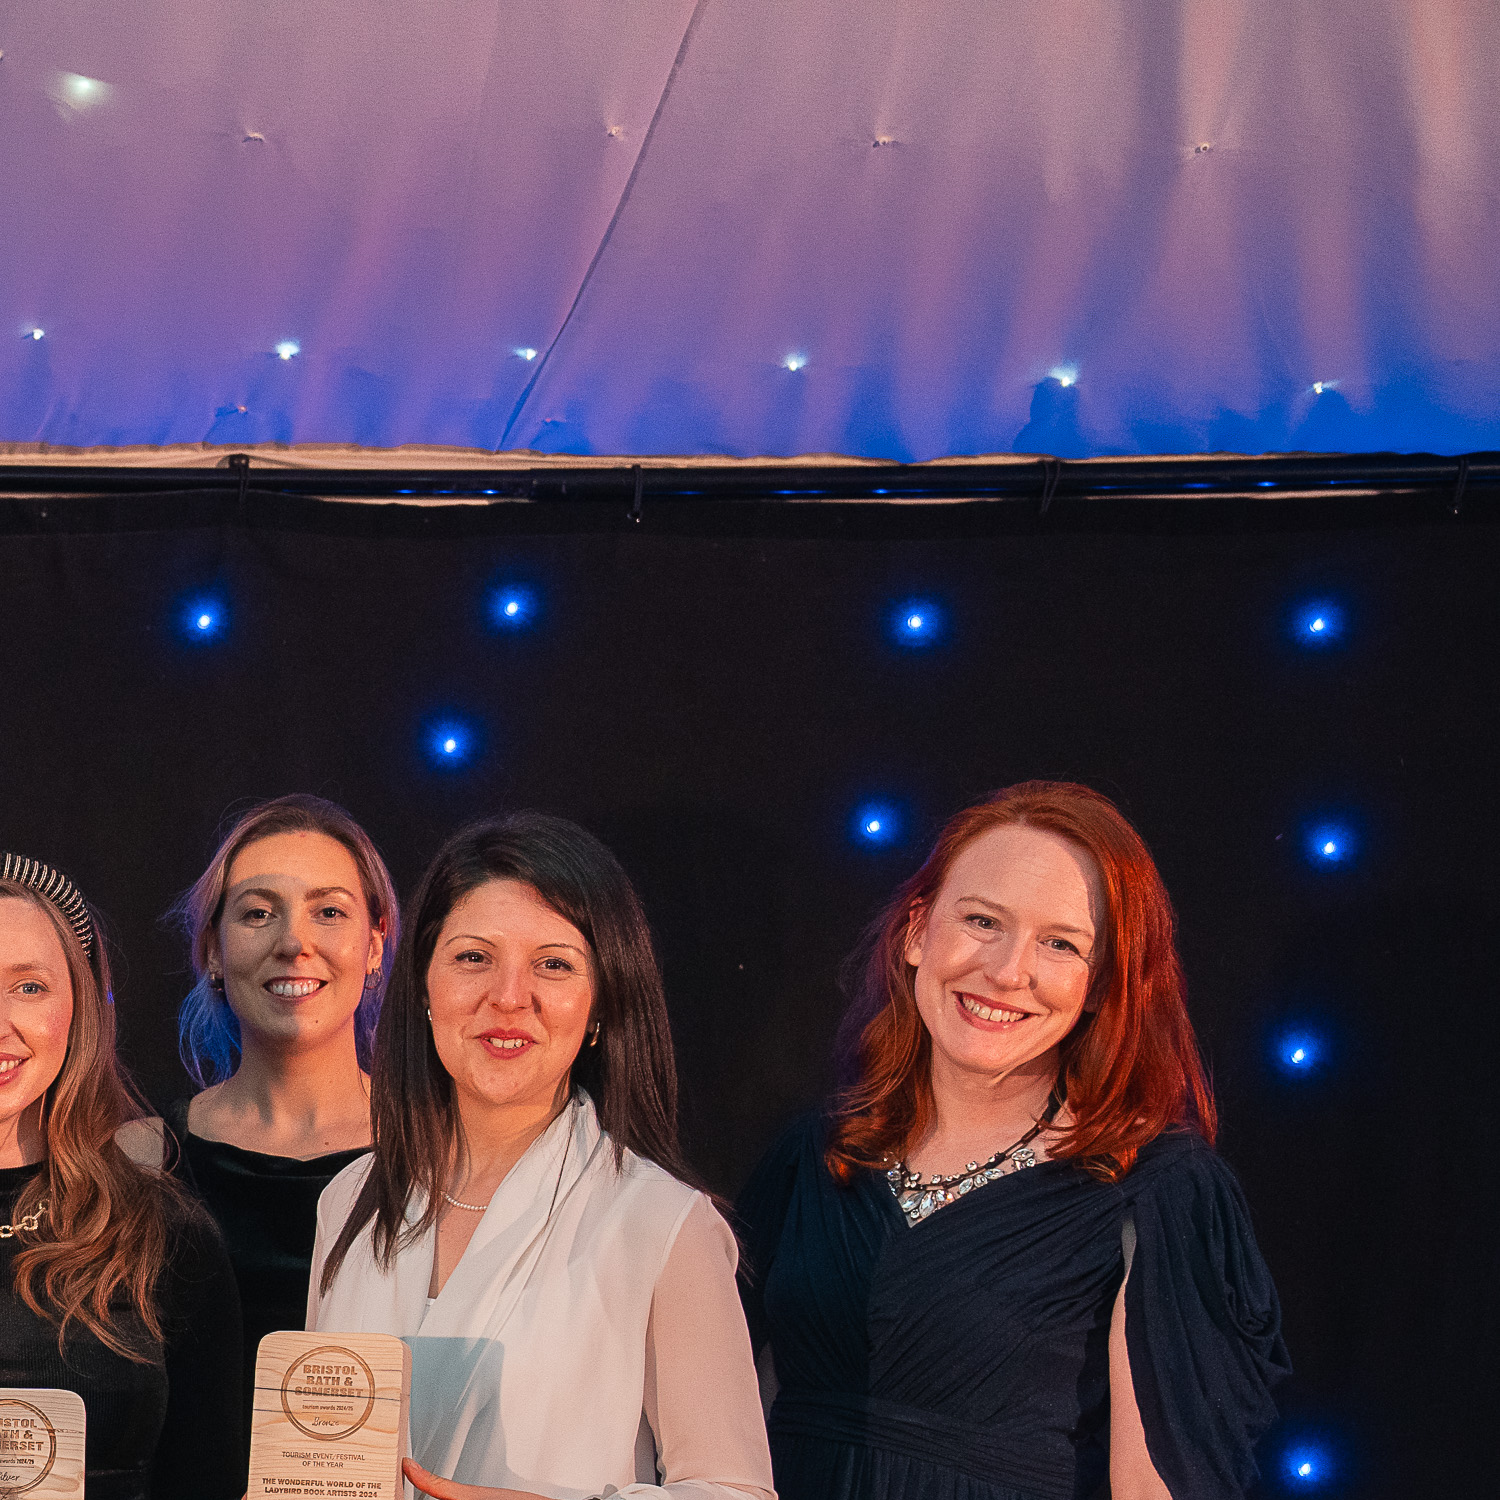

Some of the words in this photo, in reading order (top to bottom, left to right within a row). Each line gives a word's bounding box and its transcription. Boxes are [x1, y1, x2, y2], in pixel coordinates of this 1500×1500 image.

[303, 1365, 357, 1375] BRISTOL
[306, 1376, 340, 1385] BATH
[344, 1377, 353, 1386] &
[295, 1386, 363, 1397] SOMERSET
[312, 1417, 339, 1426] Bronze
[24, 1430, 33, 1439] &
[282, 1451, 311, 1459] TOURISM
[278, 1479, 324, 1487] WONDERFUL
